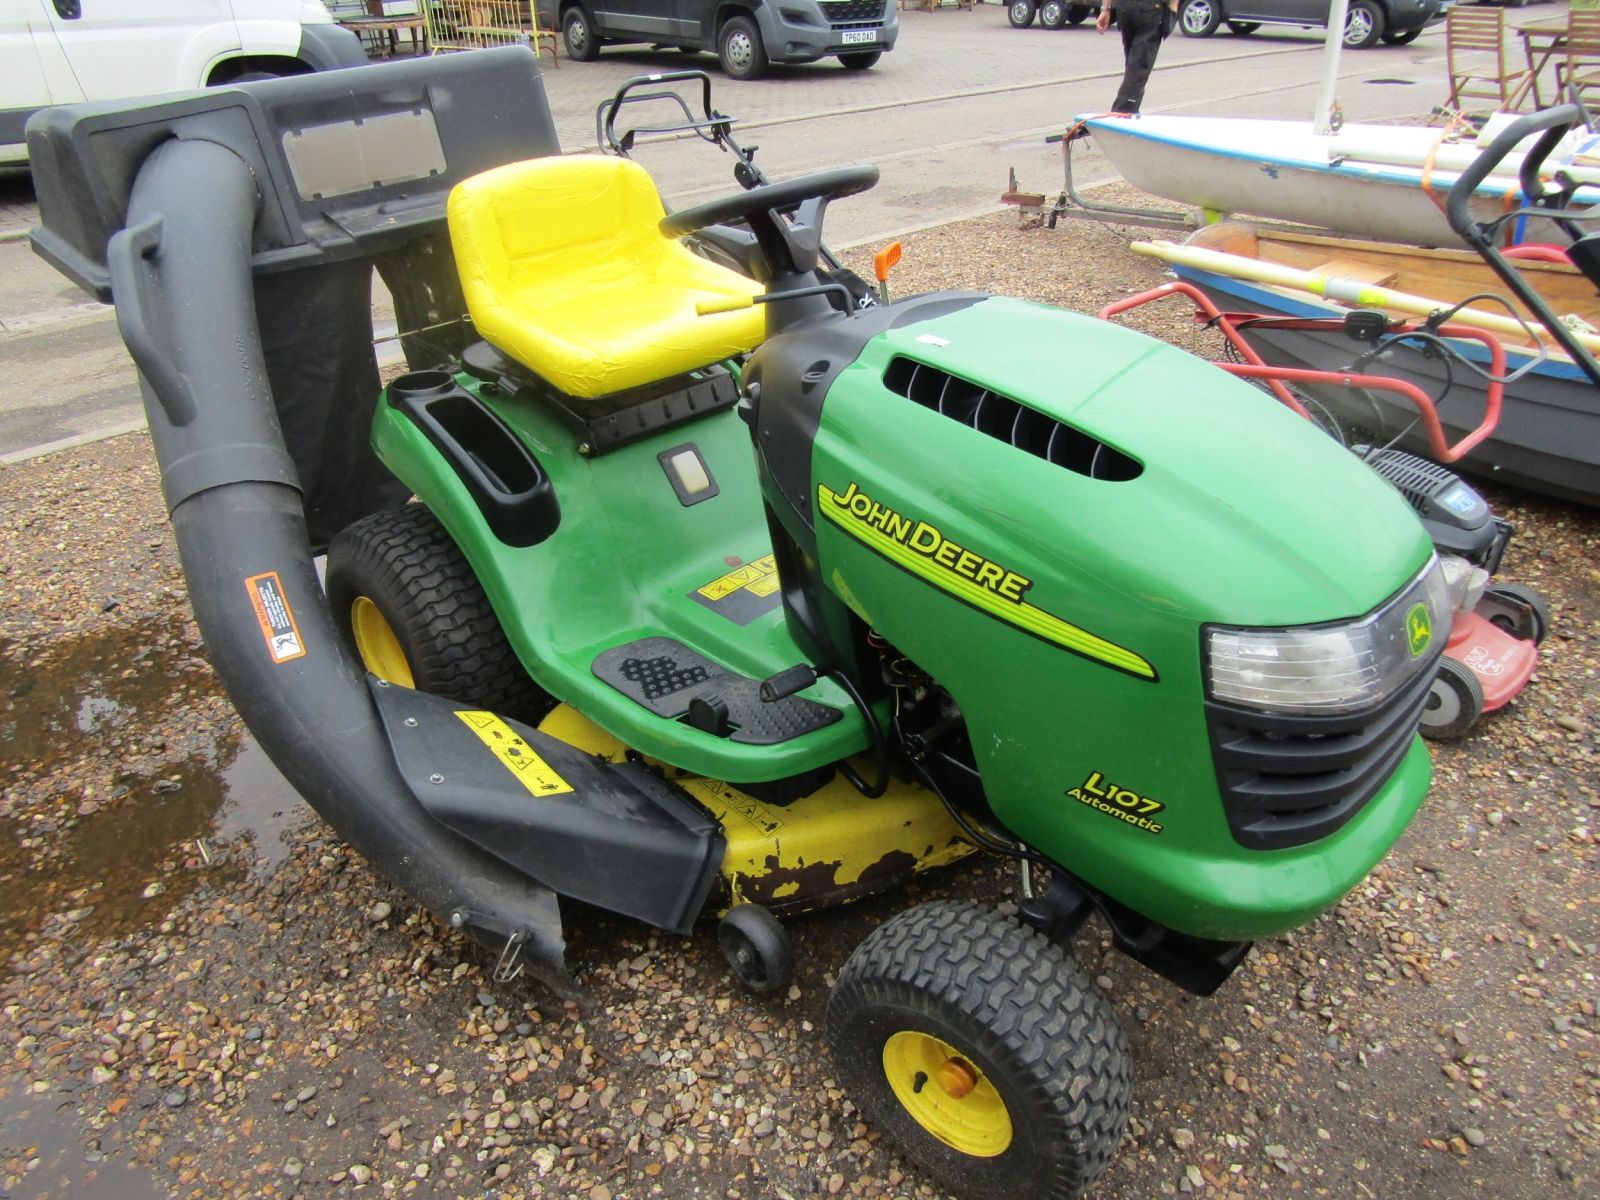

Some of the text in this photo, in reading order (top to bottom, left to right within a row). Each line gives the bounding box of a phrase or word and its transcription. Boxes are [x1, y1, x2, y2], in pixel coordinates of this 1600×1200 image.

[832, 482, 1031, 602] JOHN DEERE
[1066, 787, 1163, 834] Automatic
[1083, 771, 1162, 814] L107
